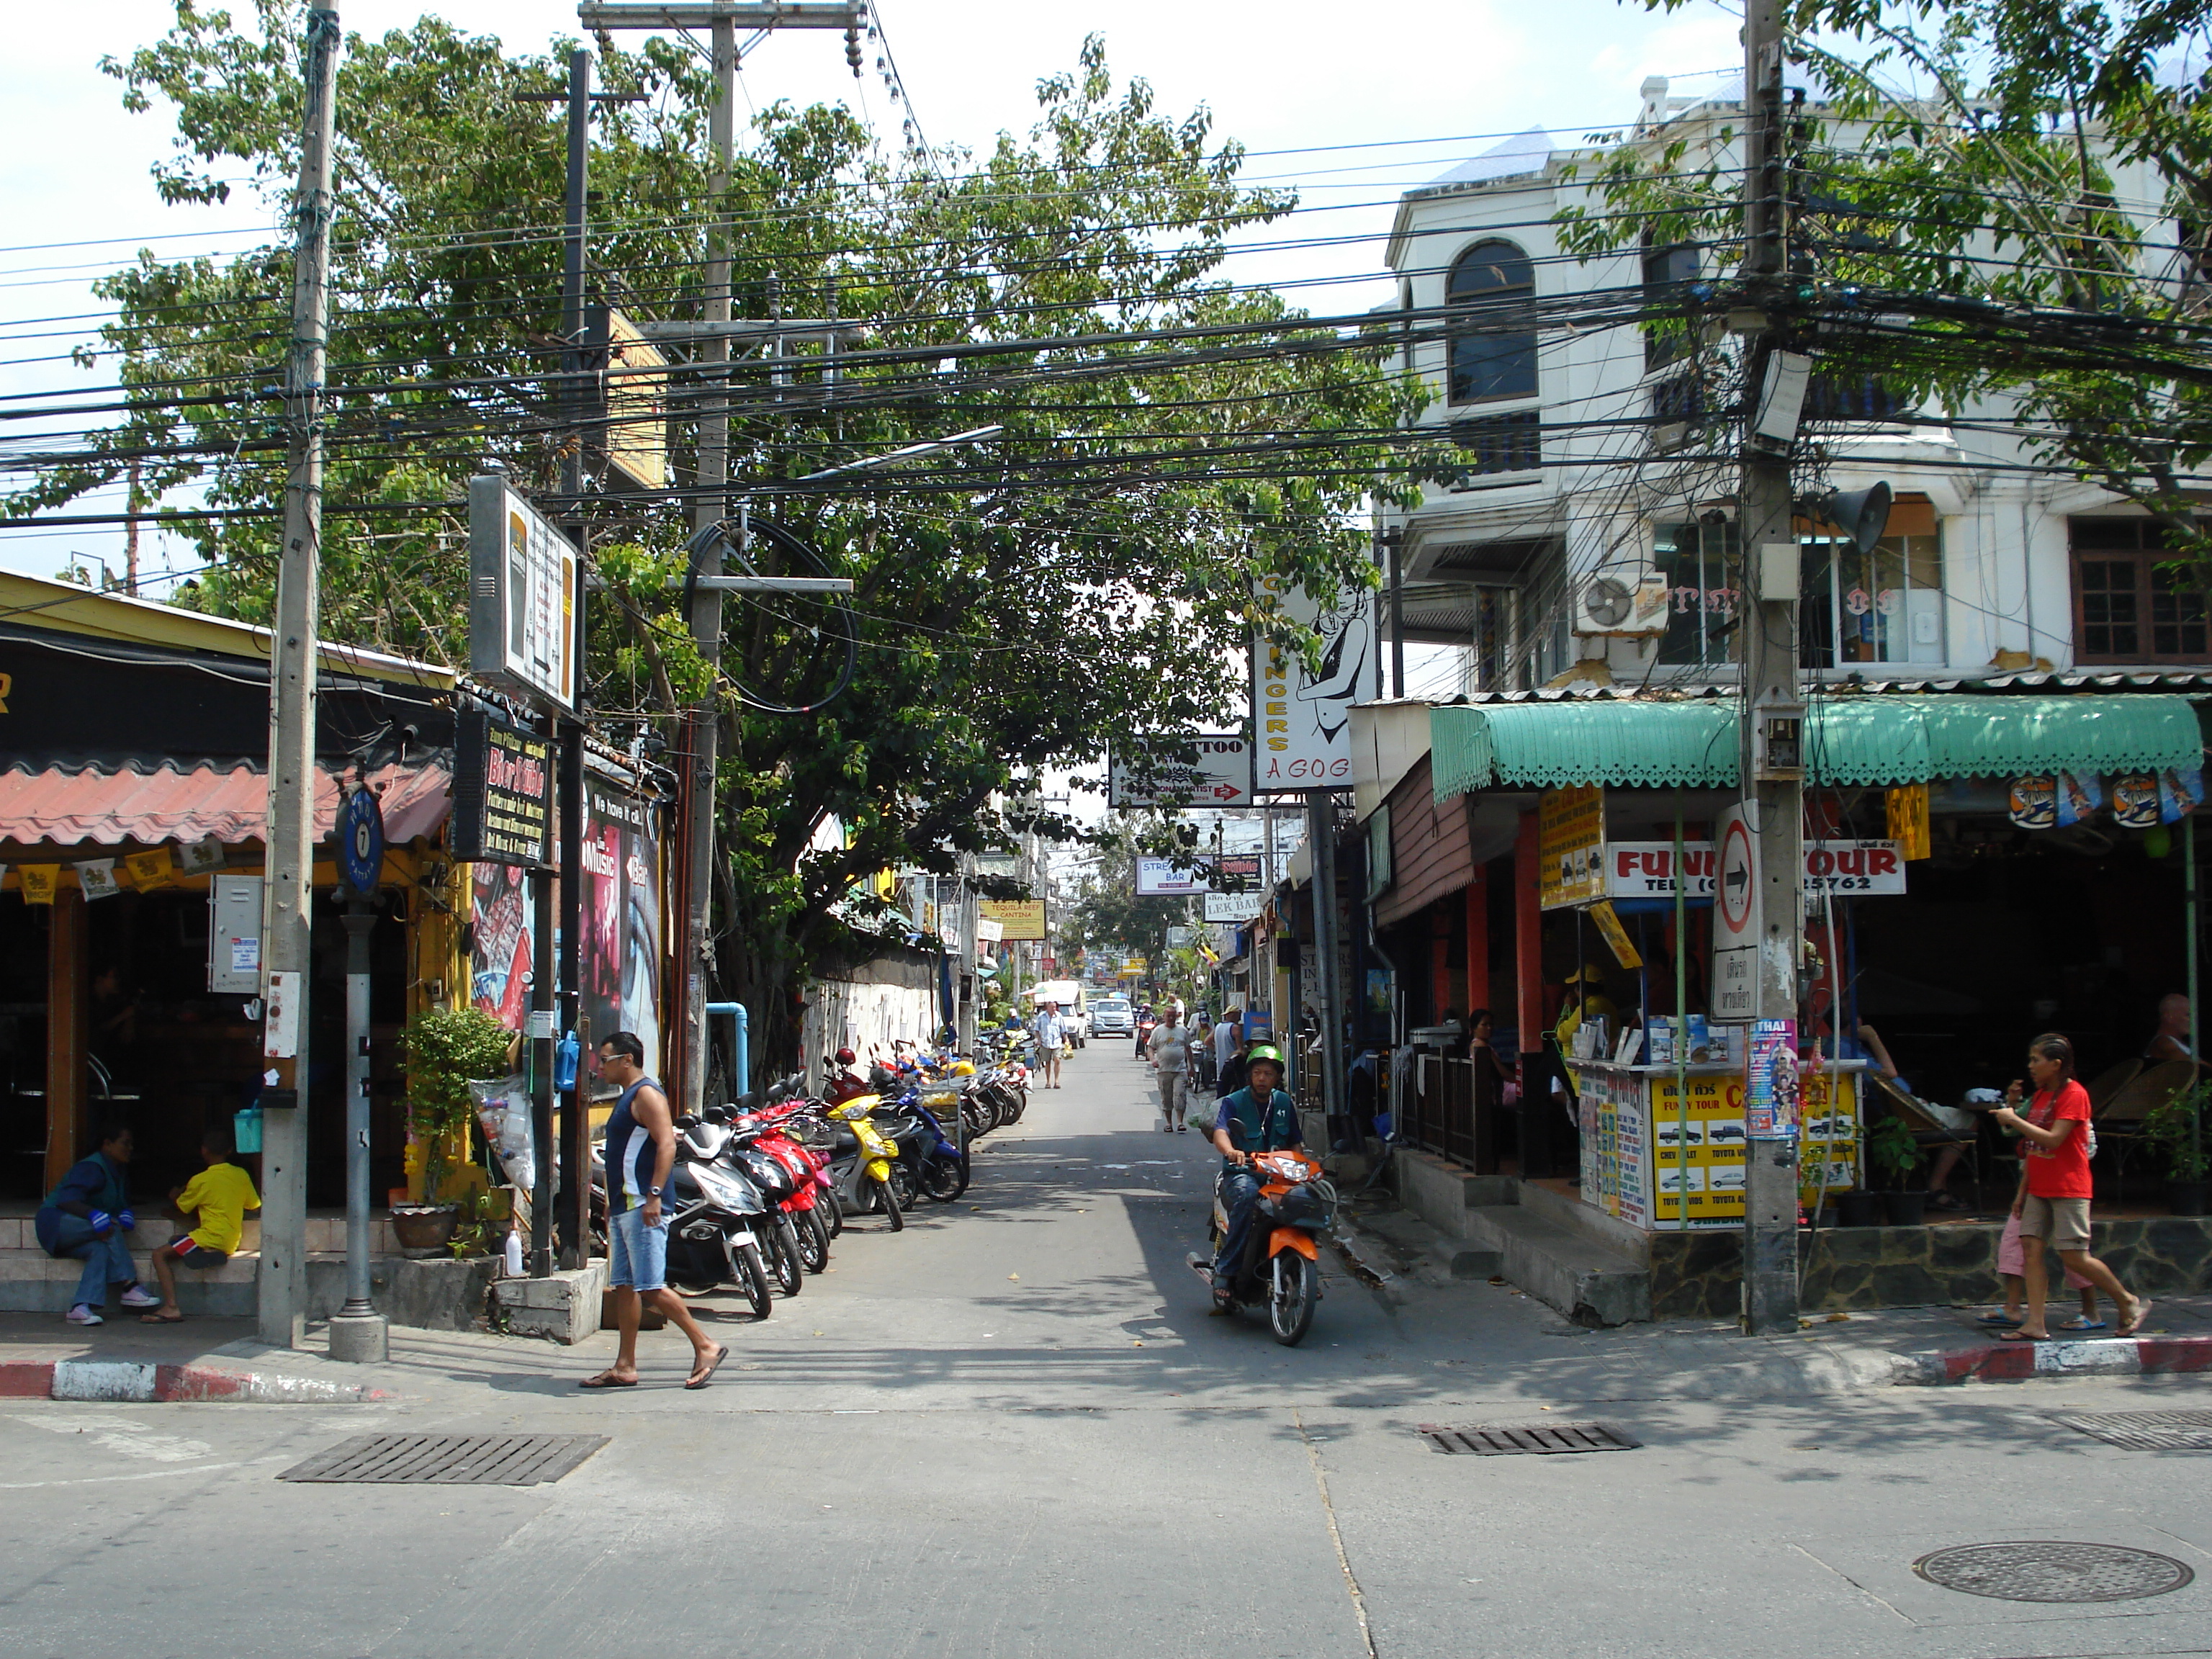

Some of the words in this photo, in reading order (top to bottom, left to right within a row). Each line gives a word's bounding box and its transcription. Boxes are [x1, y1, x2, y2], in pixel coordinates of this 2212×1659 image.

[488, 746, 516, 791] Bier
[1267, 758, 1280, 778] A
[594, 793, 605, 812] We
[606, 798, 623, 818] have
[624, 806, 629, 822] it
[361, 831, 366, 850] 7
[586, 840, 615, 877] Music
[632, 857, 647, 886] Bar
[1208, 902, 1232, 914] LEK
[1696, 1100, 1720, 1110] TOUR
[1712, 1148, 1735, 1159] TOYOTA
[1689, 1196, 1703, 1206] VIOS
[1712, 1195, 1735, 1205] TOYOTA
